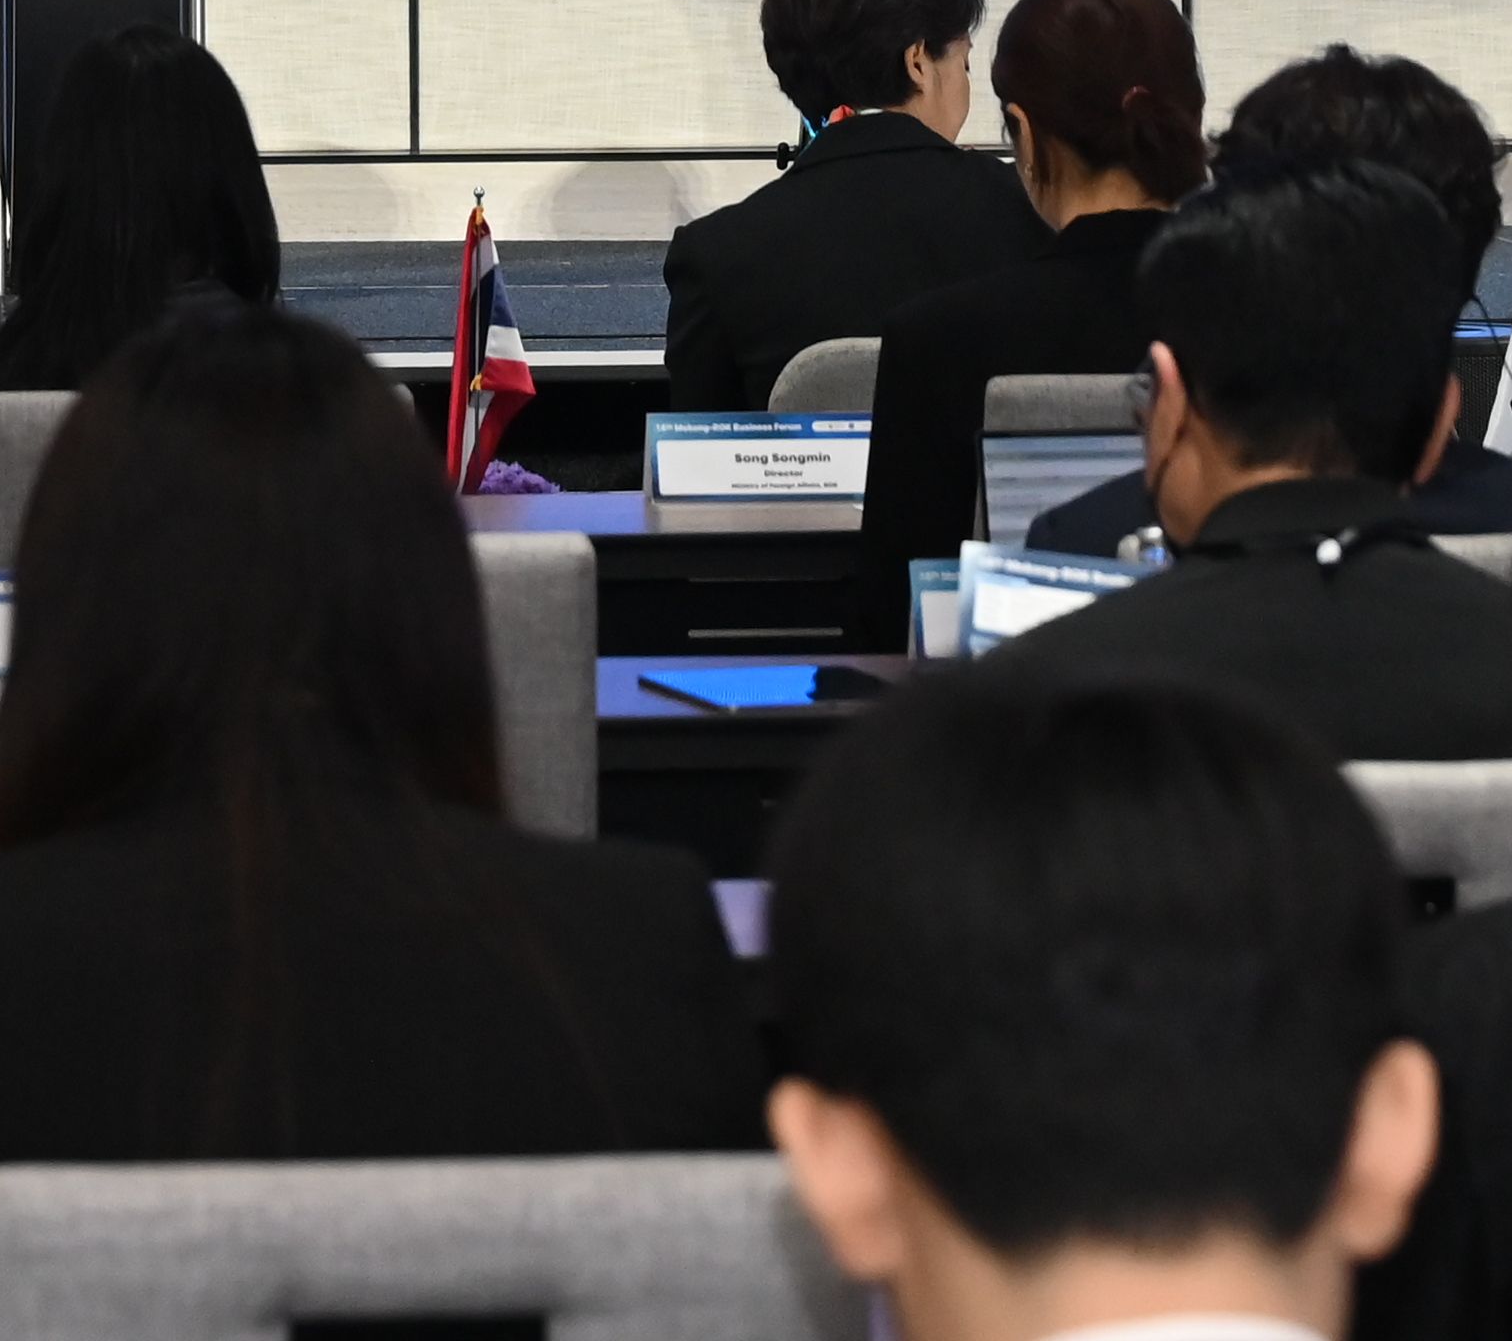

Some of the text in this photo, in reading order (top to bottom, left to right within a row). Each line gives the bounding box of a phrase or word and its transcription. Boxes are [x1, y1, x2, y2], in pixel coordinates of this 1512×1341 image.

[734, 451, 832, 466] Song Songmin
[763, 468, 804, 478] Director
